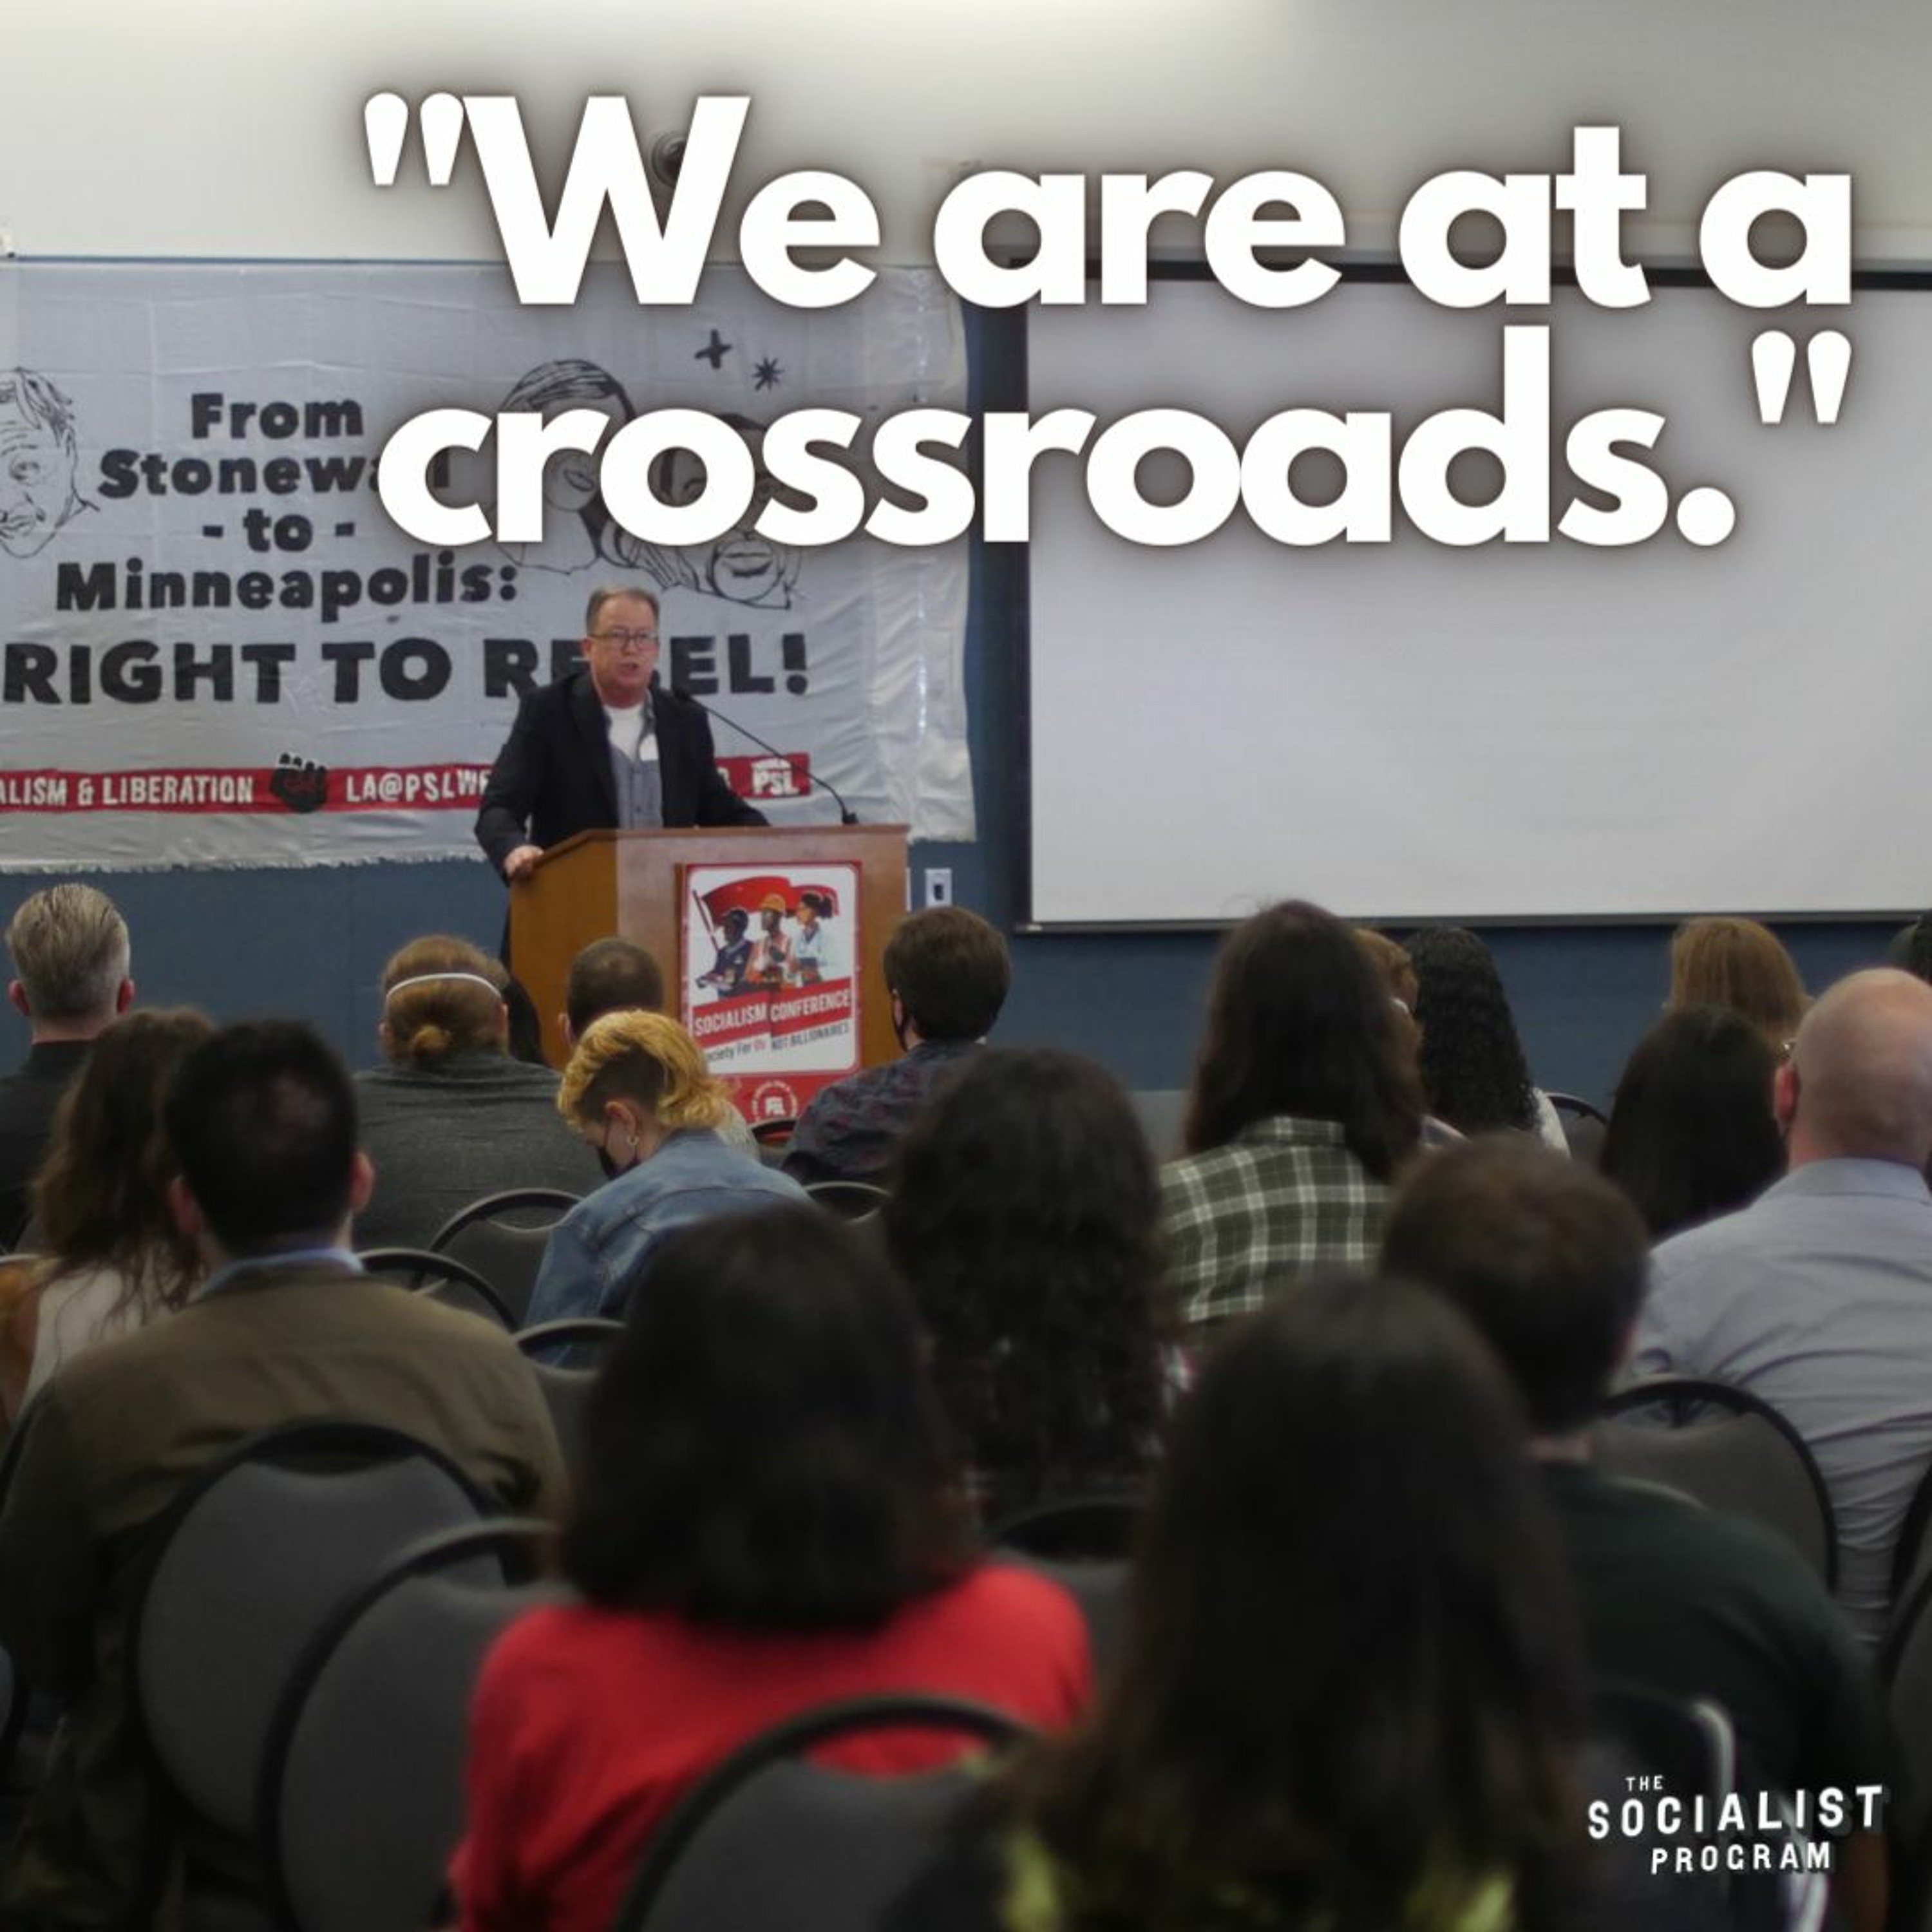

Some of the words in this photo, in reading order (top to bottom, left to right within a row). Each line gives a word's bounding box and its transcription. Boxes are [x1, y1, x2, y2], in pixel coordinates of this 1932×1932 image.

[191, 392, 365, 439] From
[98, 449, 451, 499] Stonewl
[243, 509, 312, 552] to
[56, 551, 517, 623] Minneapolis:
[3, 639, 297, 705] RIGHT
[321, 638, 452, 703] TO
[483, 633, 808, 698] REL!
[77, 777, 95, 806] &
[102, 775, 254, 805] LIBERATION
[694, 1002, 768, 1037] SOCIALISM
[770, 988, 851, 1023] CONFERENCE
